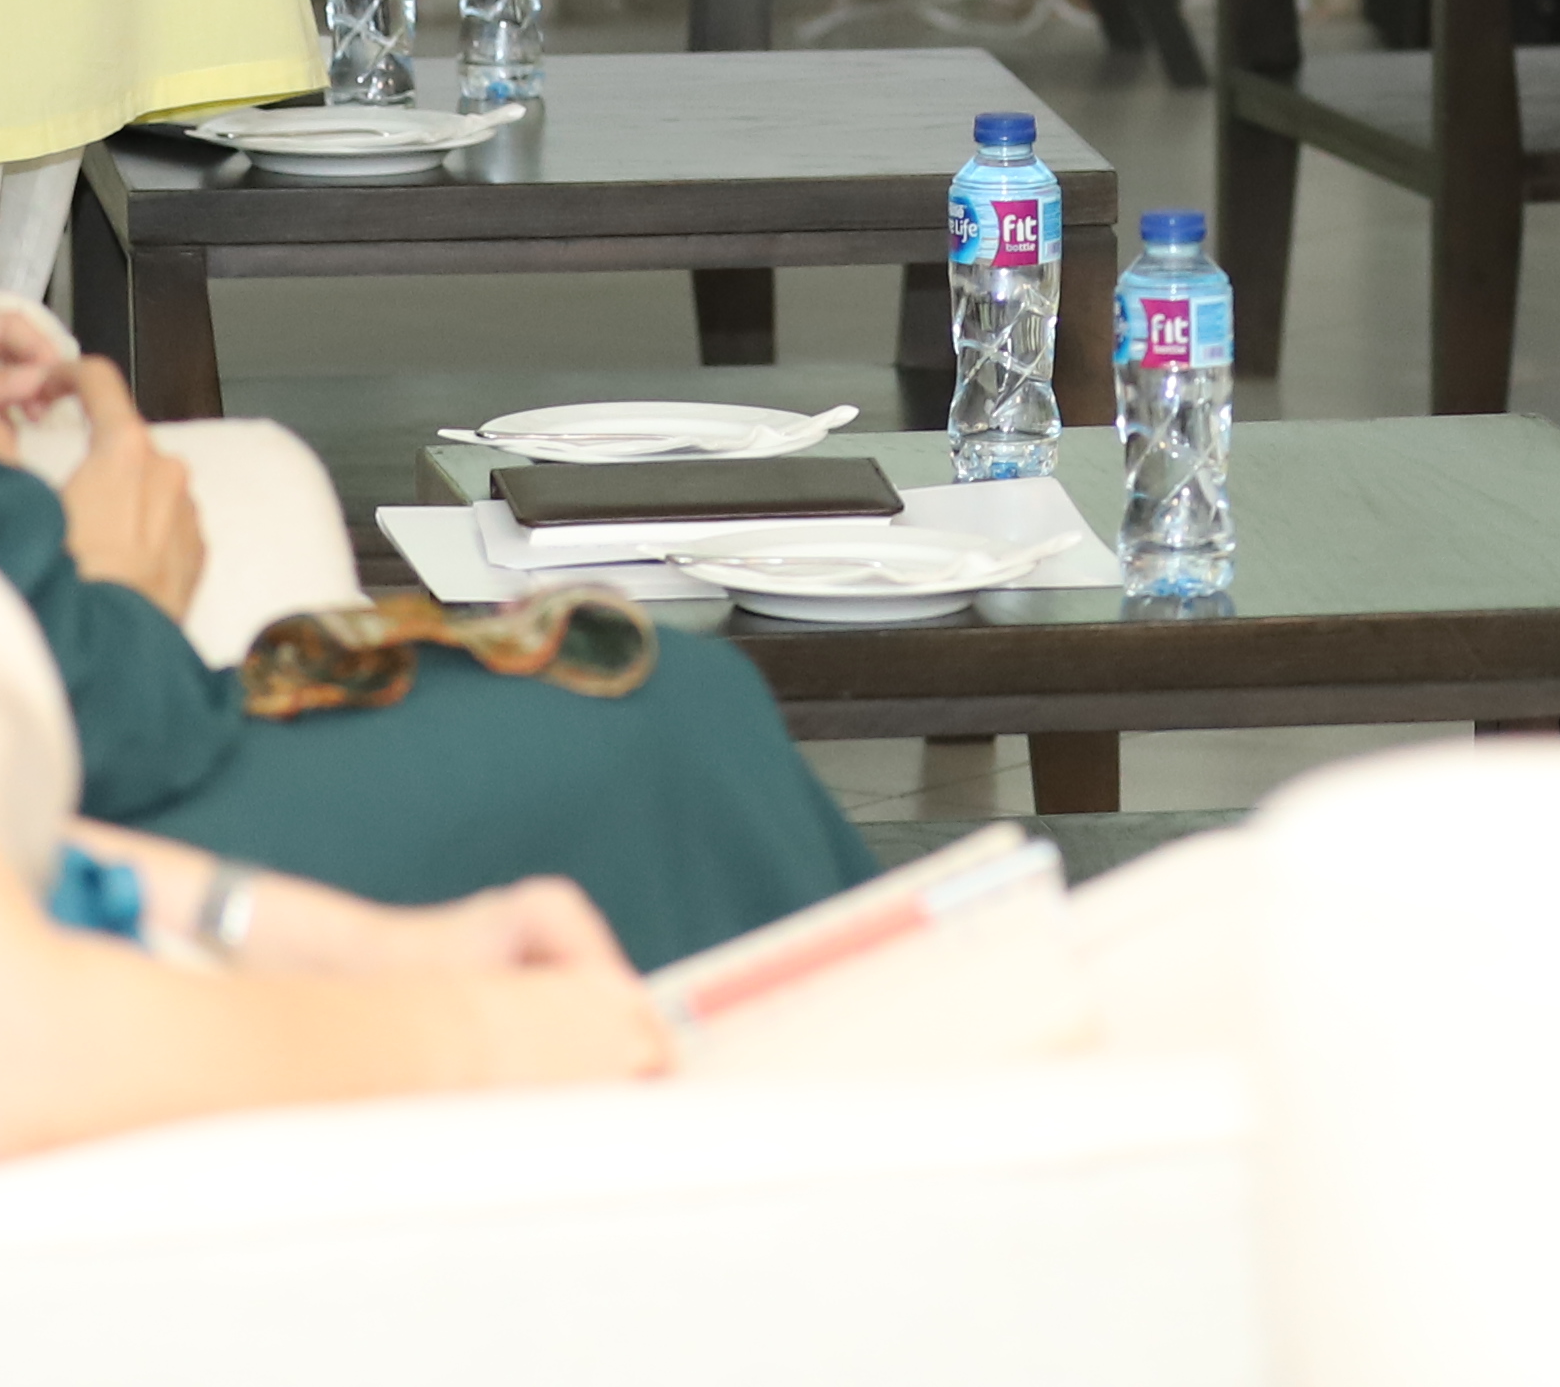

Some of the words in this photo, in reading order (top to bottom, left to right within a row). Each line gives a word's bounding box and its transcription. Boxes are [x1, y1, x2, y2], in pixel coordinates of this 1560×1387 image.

[1002, 214, 1038, 243] fit
[1005, 242, 1037, 253] bottle
[1151, 313, 1189, 344] fit
